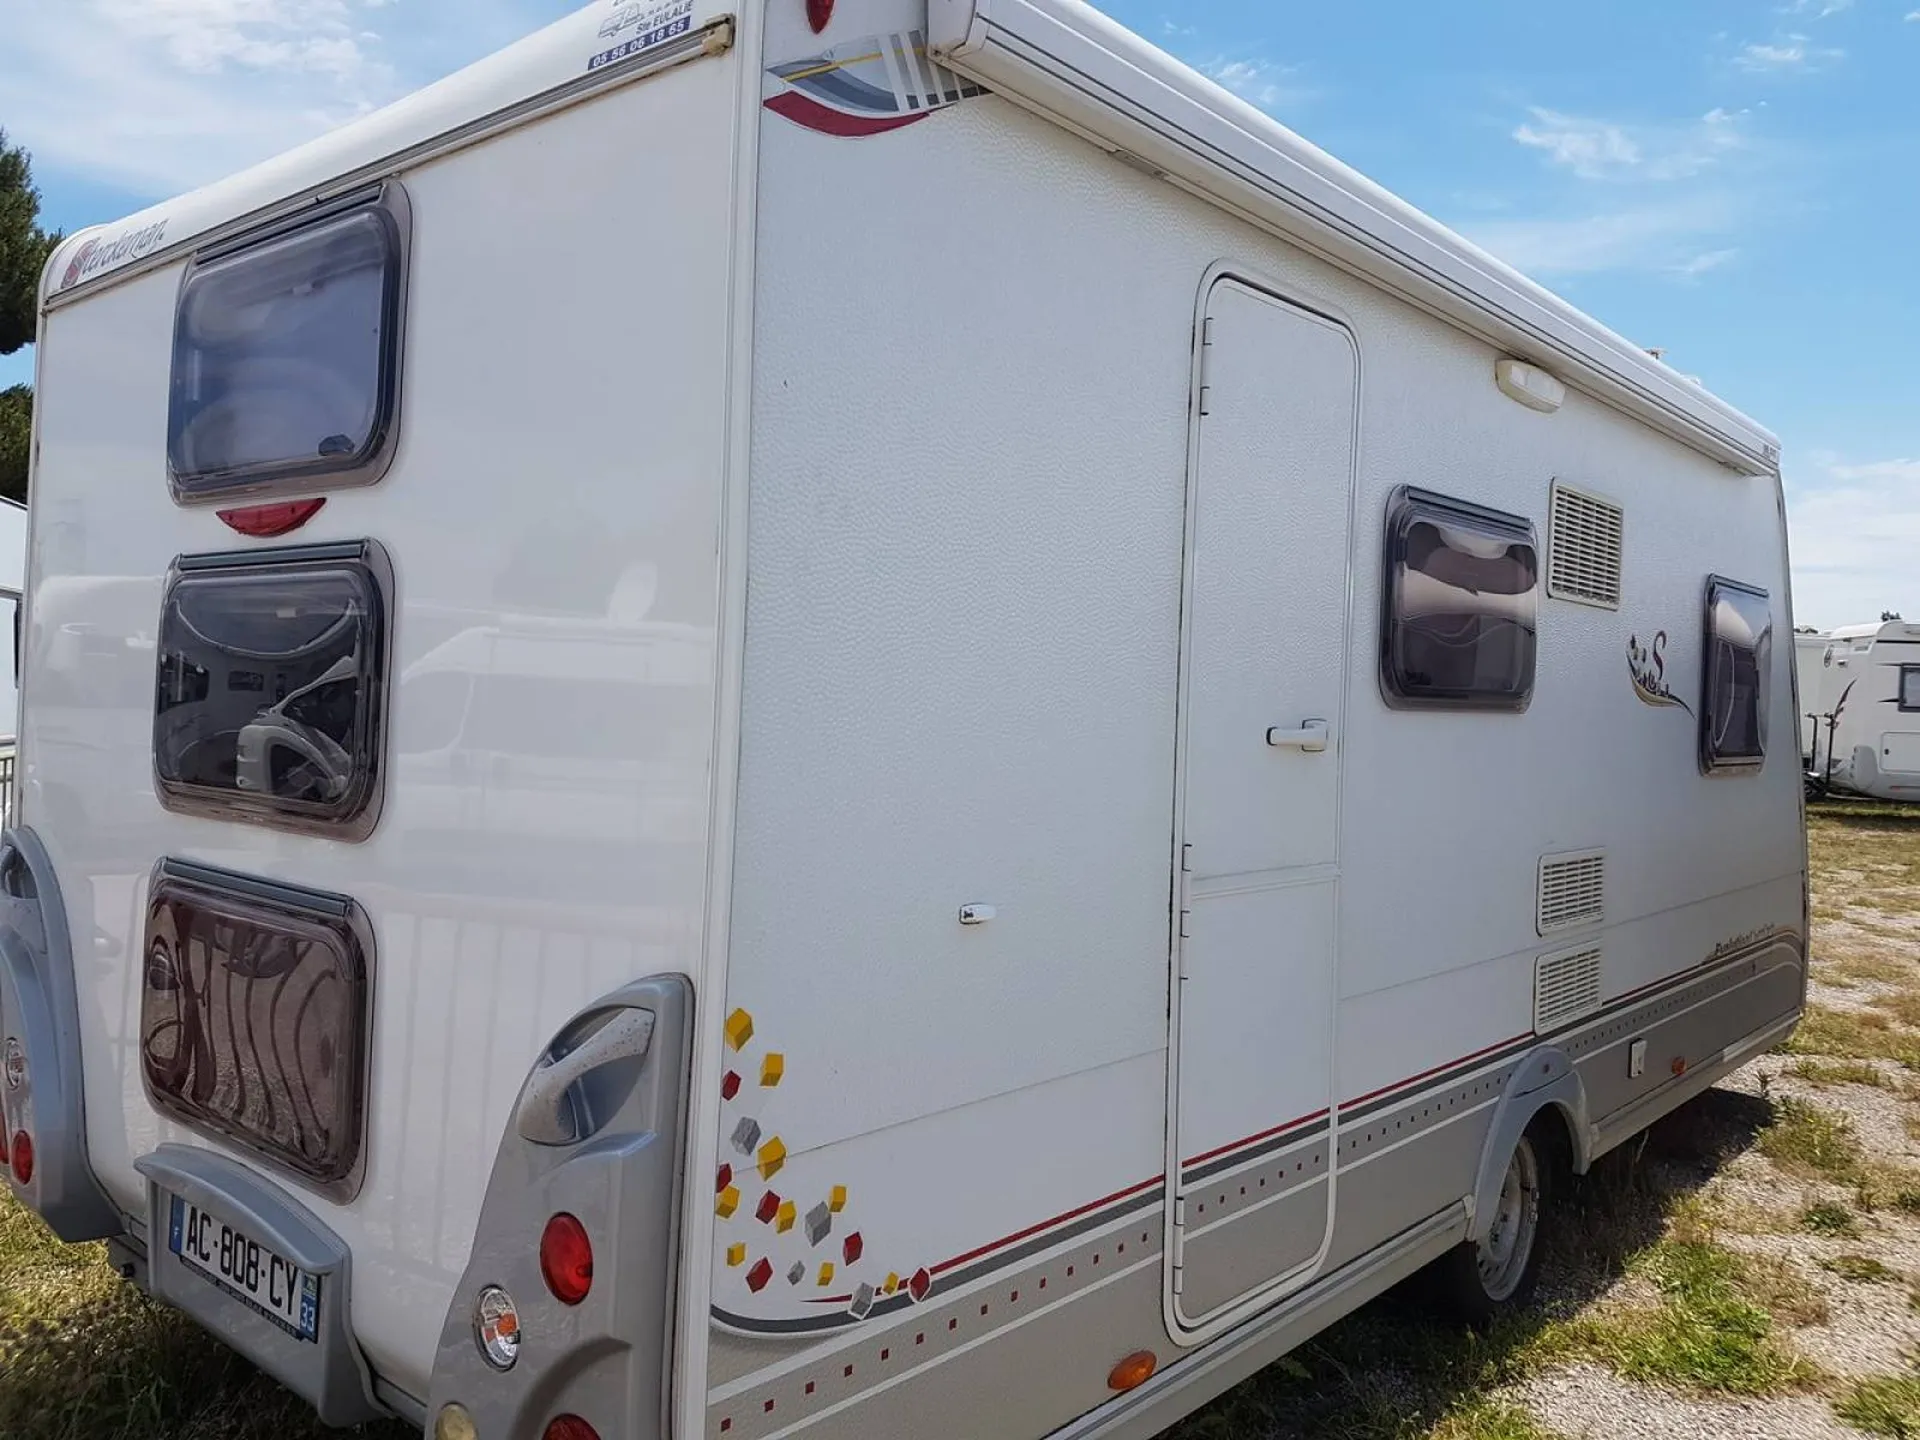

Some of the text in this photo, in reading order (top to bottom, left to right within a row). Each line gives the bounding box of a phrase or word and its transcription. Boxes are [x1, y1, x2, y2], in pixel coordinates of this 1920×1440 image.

[593, 54, 607, 67] 05
[611, 45, 626, 60] 56
[630, 38, 645, 52] 06
[651, 29, 665, 43] 18
[186, 1206, 298, 1316] AC-808-CY
[300, 1302, 316, 1333] 33
